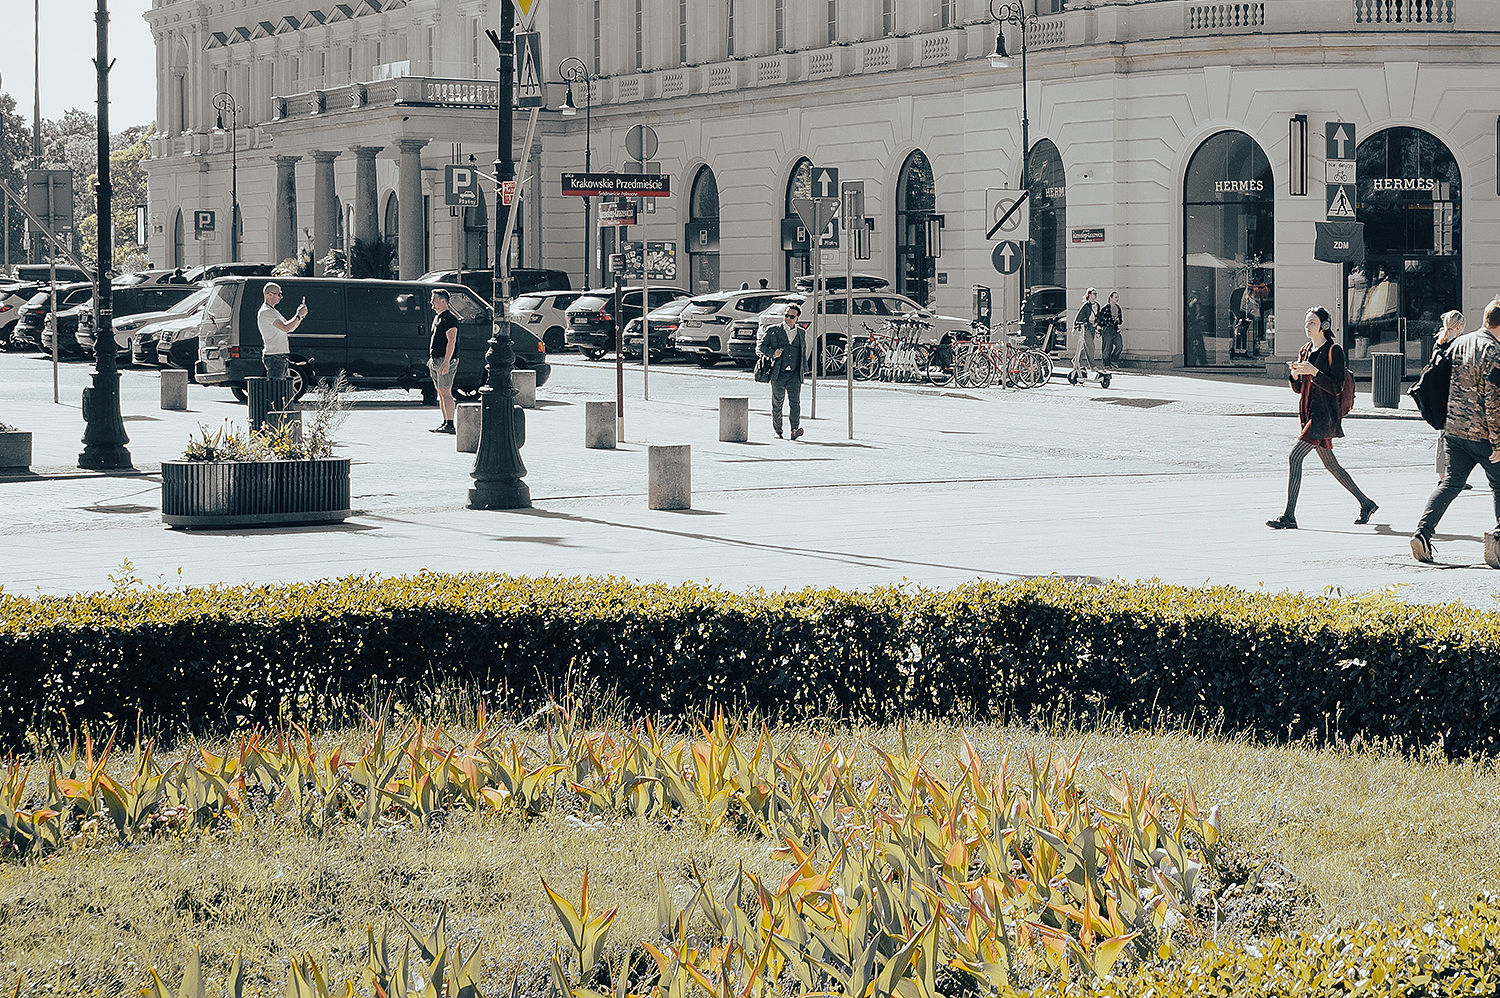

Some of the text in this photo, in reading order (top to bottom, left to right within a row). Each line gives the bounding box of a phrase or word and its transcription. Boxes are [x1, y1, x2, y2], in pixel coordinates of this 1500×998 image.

[452, 168, 472, 194] P
[570, 178, 663, 190] Krakowskie Przedmieście
[1045, 187, 1066, 197] HERM
[199, 212, 211, 229] P
[1333, 240, 1349, 250] ZDM
